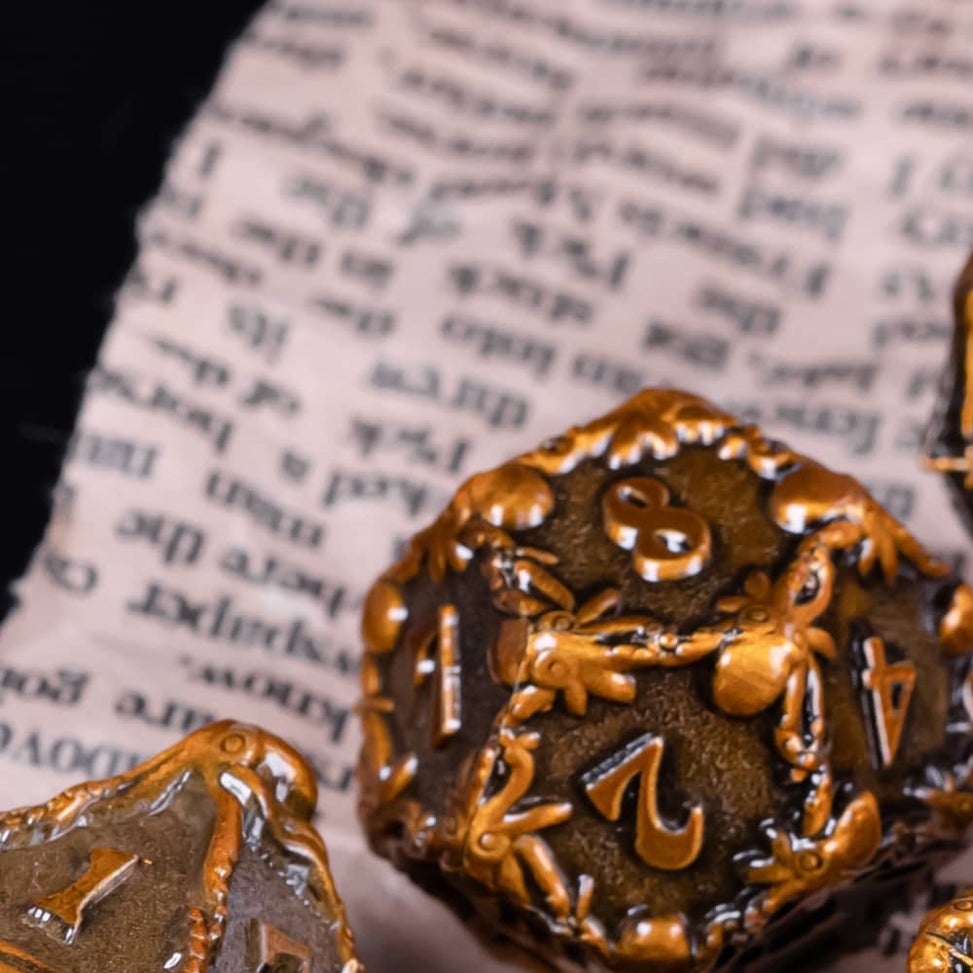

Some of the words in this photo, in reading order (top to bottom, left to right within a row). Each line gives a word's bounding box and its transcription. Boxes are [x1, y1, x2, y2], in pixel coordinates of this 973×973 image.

[114, 510, 208, 570] the
[601, 475, 713, 583] 8
[848, 634, 918, 774] 4
